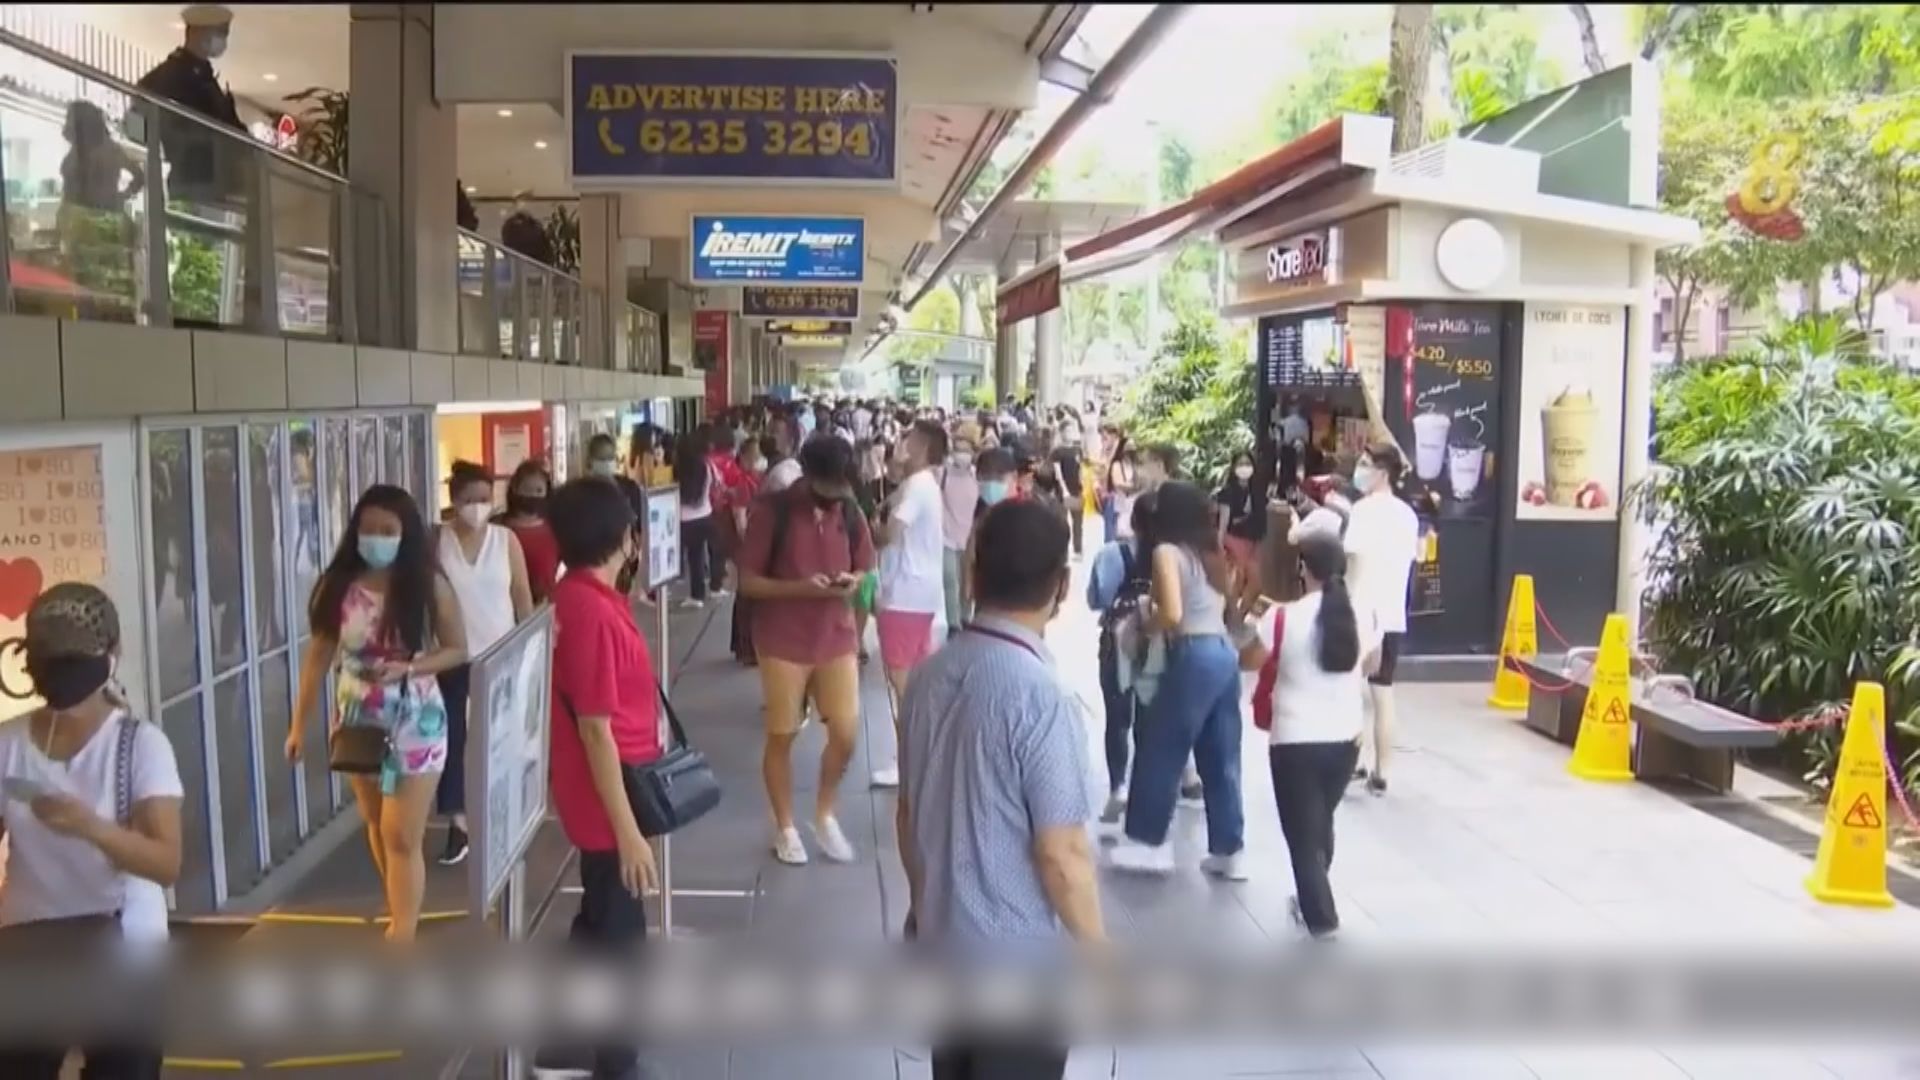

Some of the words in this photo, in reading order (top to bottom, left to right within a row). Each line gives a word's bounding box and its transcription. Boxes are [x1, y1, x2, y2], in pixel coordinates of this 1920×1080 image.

[586, 84, 786, 113] ADVERTISE
[795, 87, 886, 114] HERE
[639, 120, 747, 154] 6235
[762, 121, 872, 156] 3294
[1438, 317, 1471, 334] Milk
